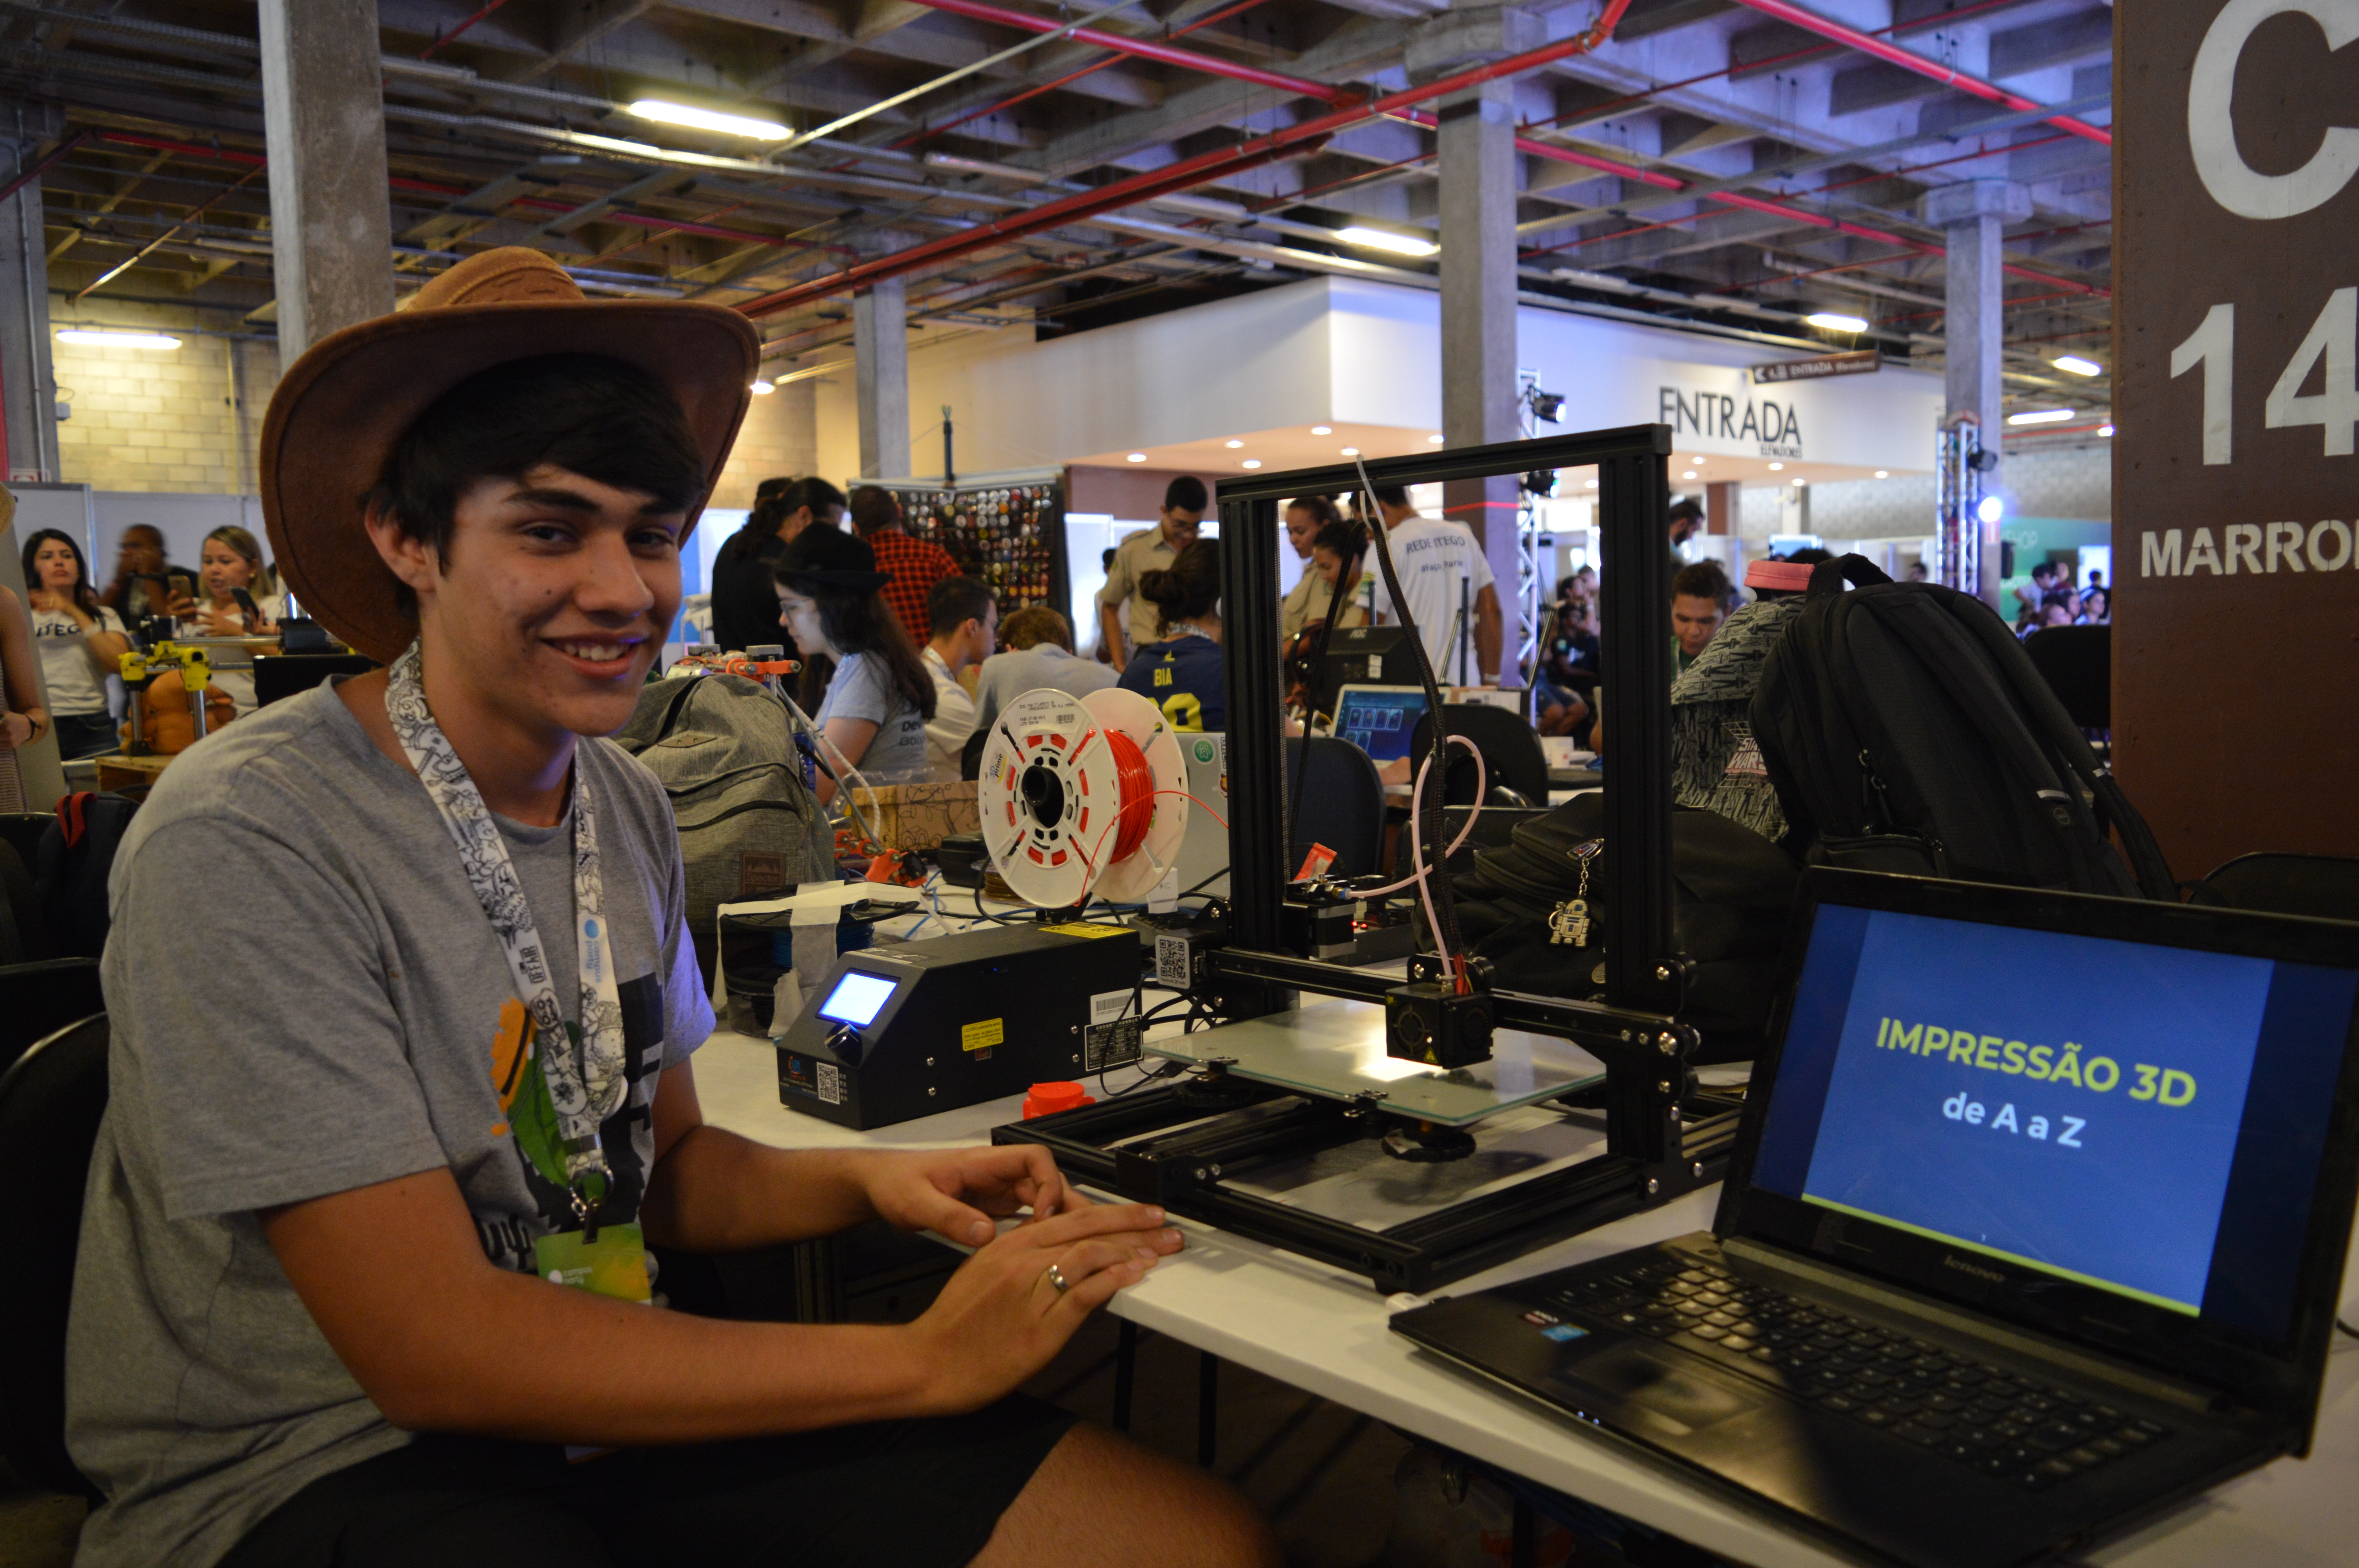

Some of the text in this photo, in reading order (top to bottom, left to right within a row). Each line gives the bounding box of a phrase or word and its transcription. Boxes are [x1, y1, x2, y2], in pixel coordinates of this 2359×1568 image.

[2188, 0, 2359, 219] C
[1790, 362, 1834, 375] ENTRADA
[2171, 287, 2359, 465] 14
[1659, 386, 1802, 445] ENTRADA
[1406, 535, 1466, 554] REDE ITEGO
[2141, 519, 2359, 577] MARRO
[36, 622, 81, 637] ITEG
[1349, 629, 1367, 639] AOC
[1154, 668, 1172, 686] BIA
[1738, 737, 1760, 751] STA
[994, 753, 1003, 778] prime
[1727, 752, 1767, 770] WARS
[746, 873, 780, 882] Spector
[594, 940, 602, 983] campus
[1876, 1017, 2197, 1107] IMPRESSÃO 3D
[1943, 1092, 2086, 1148] de A a Z
[1943, 1254, 2006, 1283] lenovo
